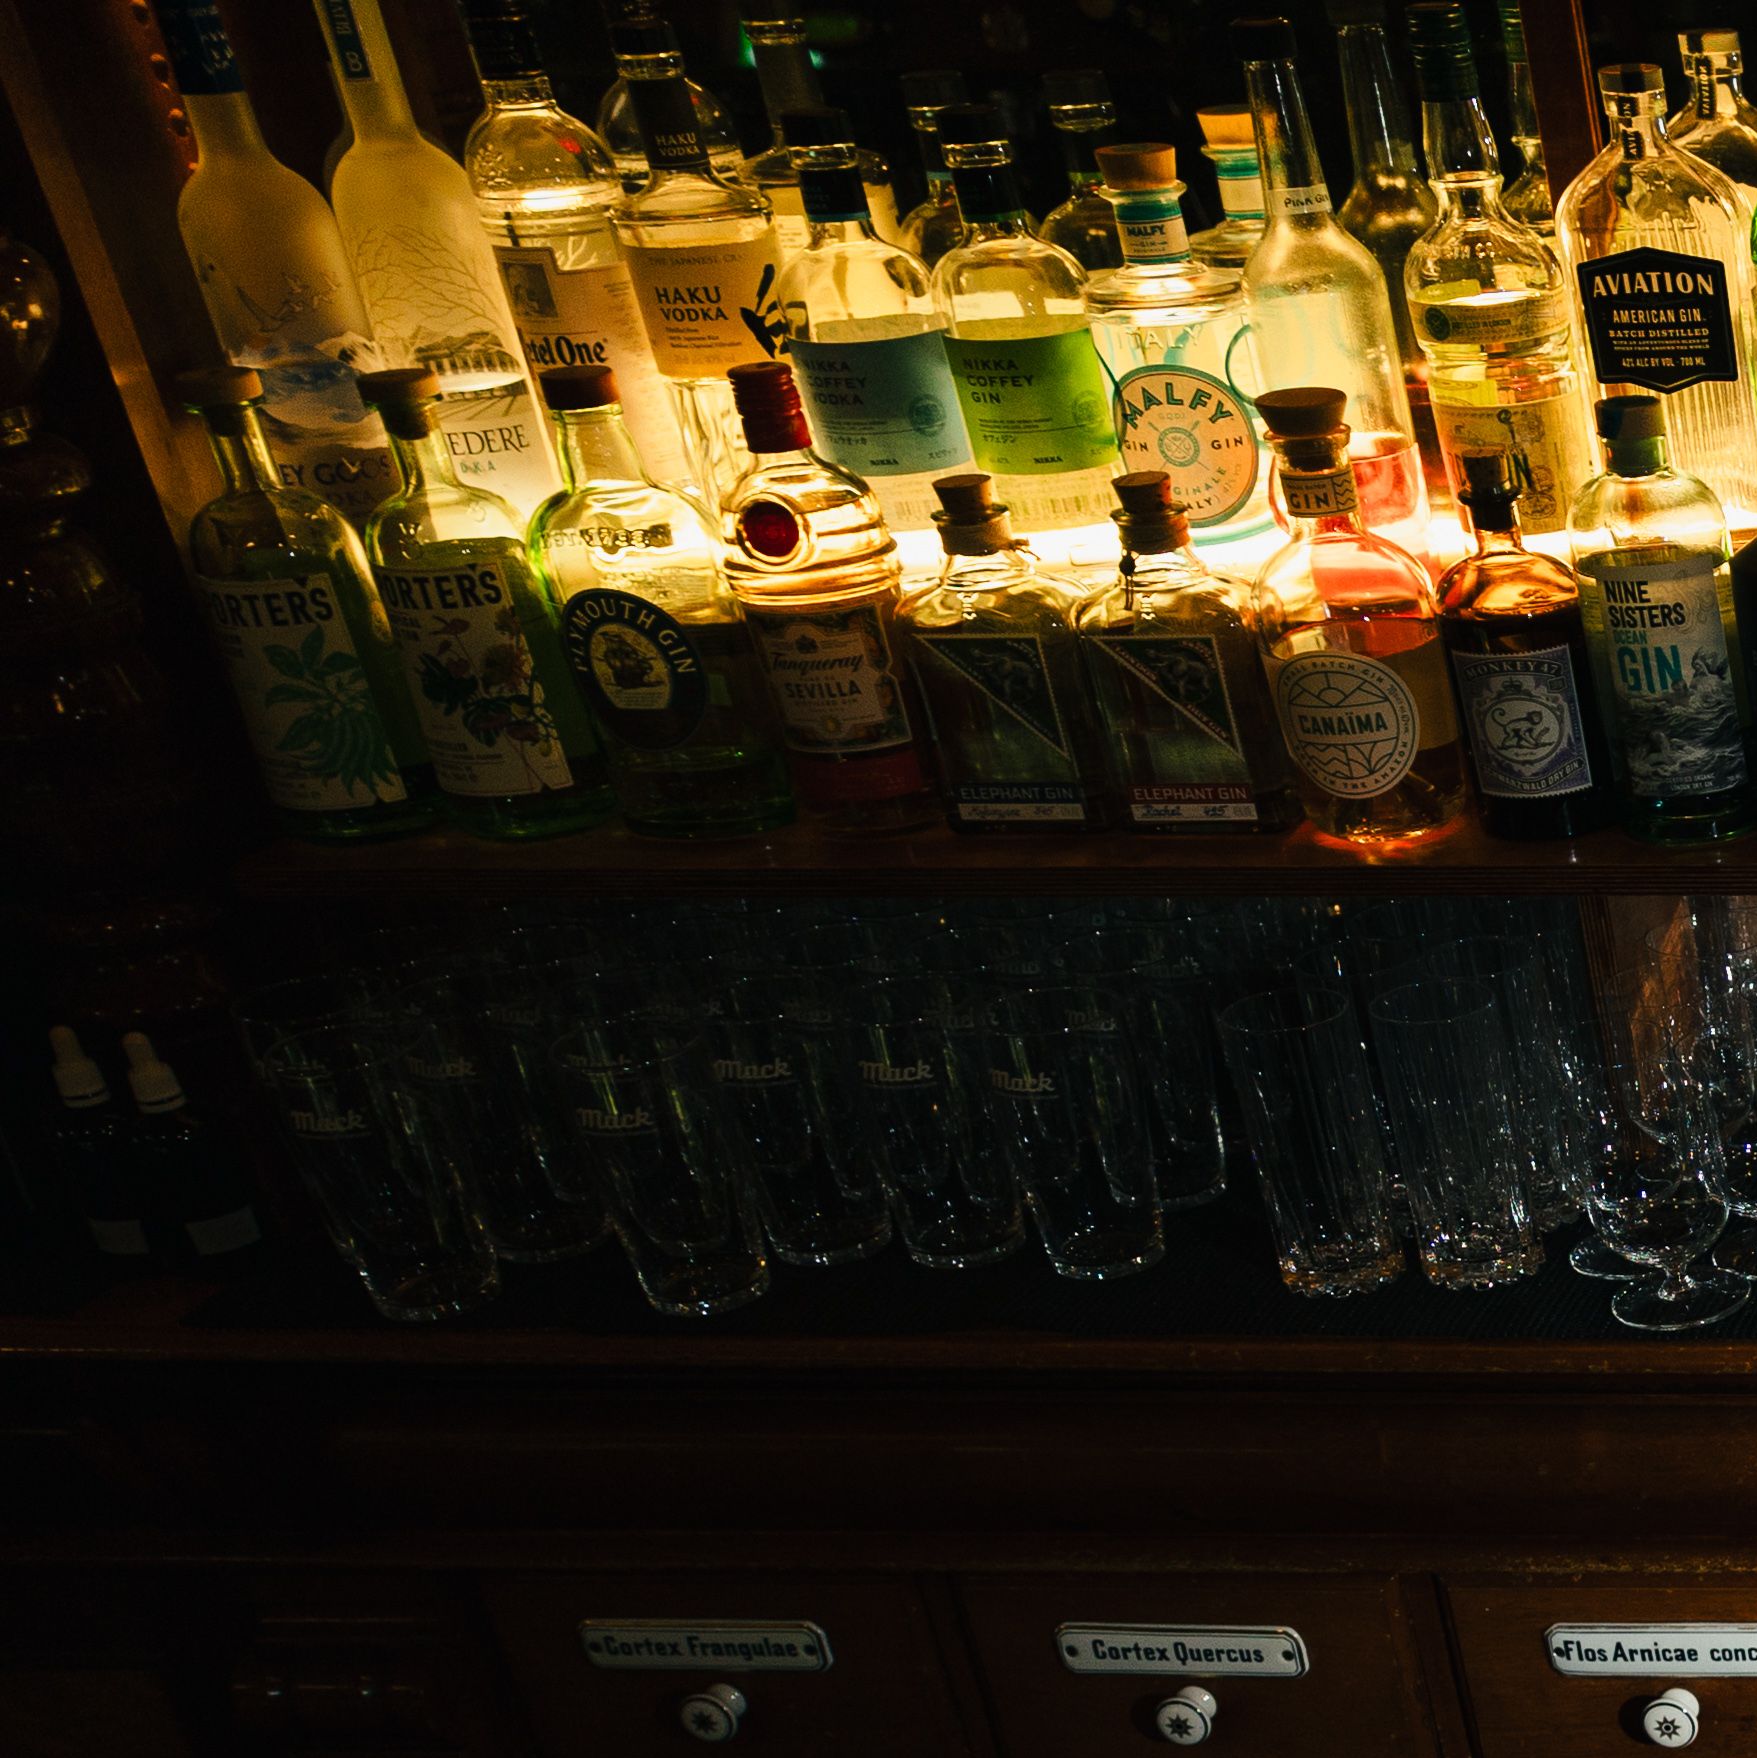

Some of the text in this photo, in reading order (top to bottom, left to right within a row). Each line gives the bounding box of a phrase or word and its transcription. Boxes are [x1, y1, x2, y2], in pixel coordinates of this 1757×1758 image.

[654, 132, 697, 148] HAKU
[1126, 225, 1167, 238] MALFY
[655, 286, 721, 304] HAKU
[1593, 271, 1715, 298] AVIATION
[660, 307, 729, 322] VODKA
[1613, 308, 1702, 323] AMERICAN GIN
[1608, 328, 1710, 338] BATCH DISTILLED
[559, 336, 606, 364] One
[963, 359, 1019, 372] NIKKA
[966, 375, 1034, 387] COFFEY
[971, 391, 1001, 404] GIN
[1121, 382, 1234, 430] MALFY
[1123, 439, 1149, 452] GIN
[1211, 436, 1244, 451] GIN
[1290, 490, 1331, 510] GIN
[1604, 580, 1651, 603] NINE
[1608, 602, 1686, 629] SISTERS
[574, 601, 699, 677] PLYMOUTH GIN
[1613, 630, 1648, 644] OCEAN
[769, 651, 864, 676] Tanqueray
[1464, 660, 1560, 679] MONKEY 47
[1616, 645, 1684, 694] GIN
[785, 680, 862, 699] SEVILLA
[1298, 711, 1389, 736] CANAÏMA
[960, 786, 1074, 800] ELEPHANT GIN
[1133, 787, 1249, 801] ELEPHANT GIN
[716, 1057, 793, 1081] Mack
[859, 1058, 935, 1083] Mack
[990, 1069, 1057, 1093] Mack
[291, 1109, 367, 1132] Mack
[579, 1107, 655, 1129] Mack
[604, 1634, 798, 1662] Cortex Frangulae
[1091, 1639, 1265, 1666] Cortex Quercus
[1562, 1640, 1608, 1663] Flos
[1612, 1641, 1699, 1663] Arnicae
